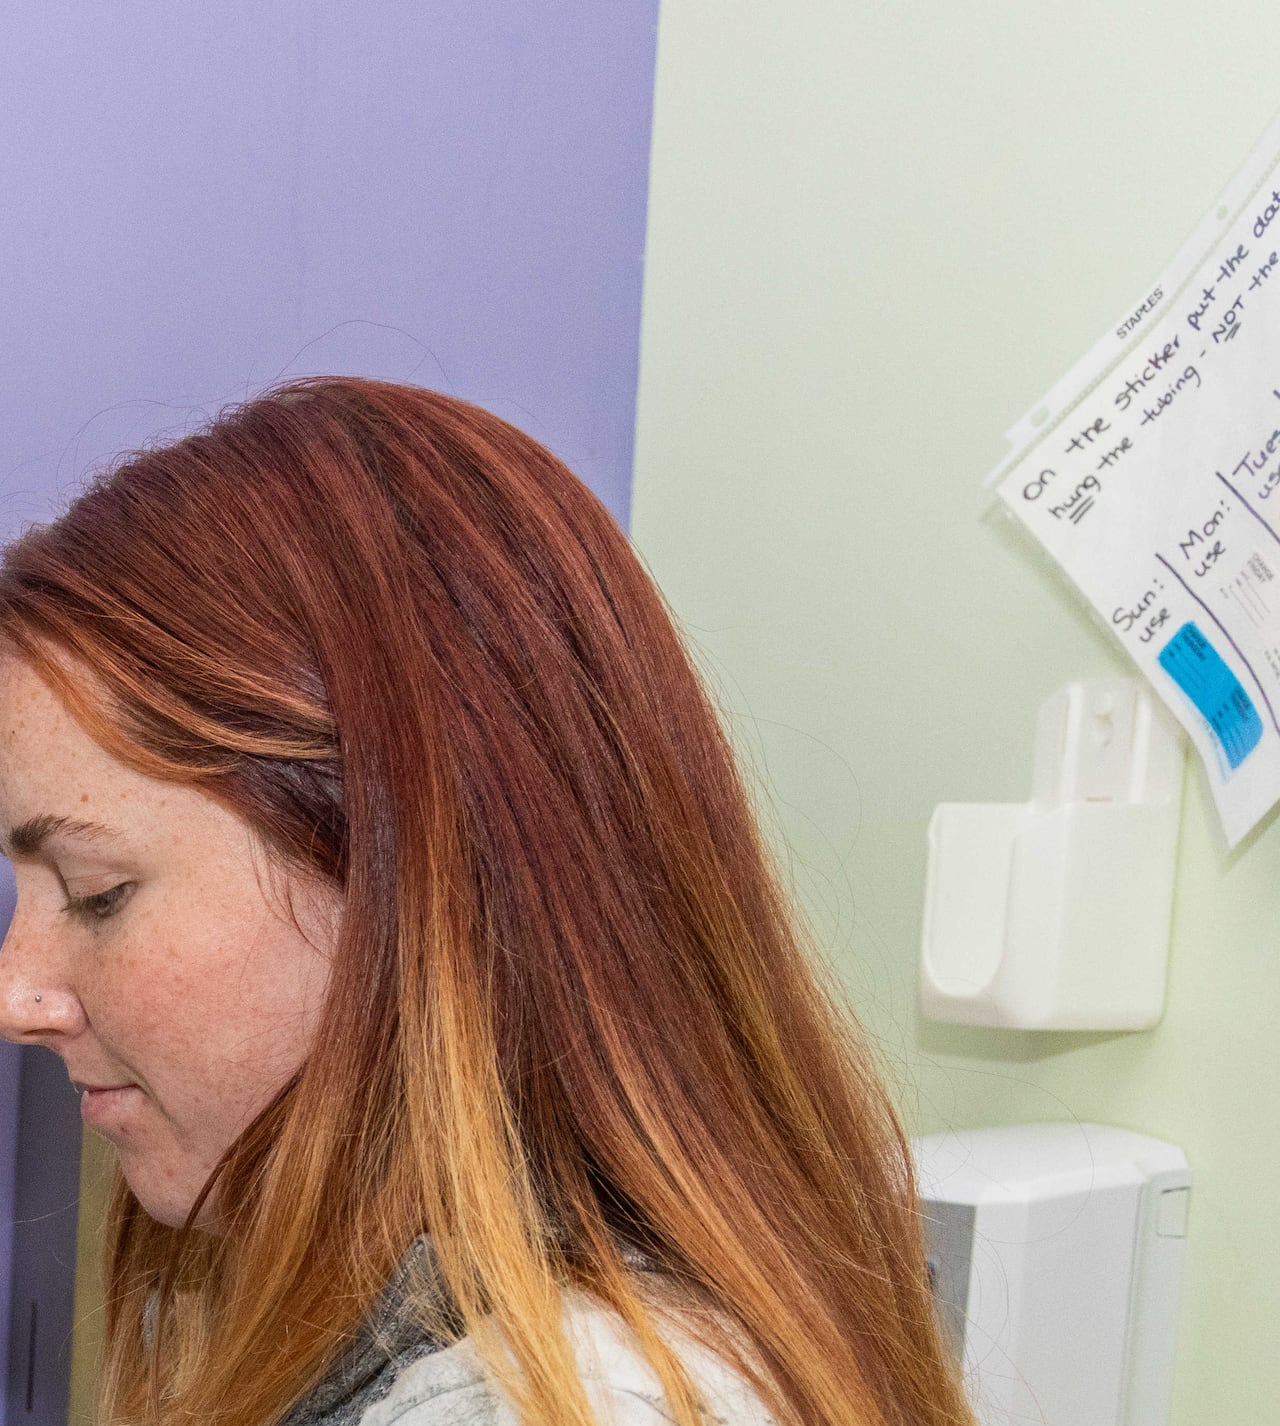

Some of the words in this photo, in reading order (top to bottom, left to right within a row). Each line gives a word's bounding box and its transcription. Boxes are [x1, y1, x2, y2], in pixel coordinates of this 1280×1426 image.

[1116, 290, 1164, 339] STAPLES
[1020, 466, 1059, 504] On
[1065, 416, 1112, 454] the
[1115, 334, 1181, 411] sticker
[1187, 286, 1217, 331] put
[1217, 244, 1249, 283] the
[1049, 473, 1104, 523] hung
[1096, 435, 1133, 471] the
[1140, 364, 1202, 426] tubing
[1212, 294, 1245, 343] NOT
[1248, 252, 1279, 292] the
[1179, 500, 1231, 560] Mon:
[1194, 539, 1227, 578] use
[1111, 579, 1165, 632] Sun:
[1140, 607, 1172, 644] use
